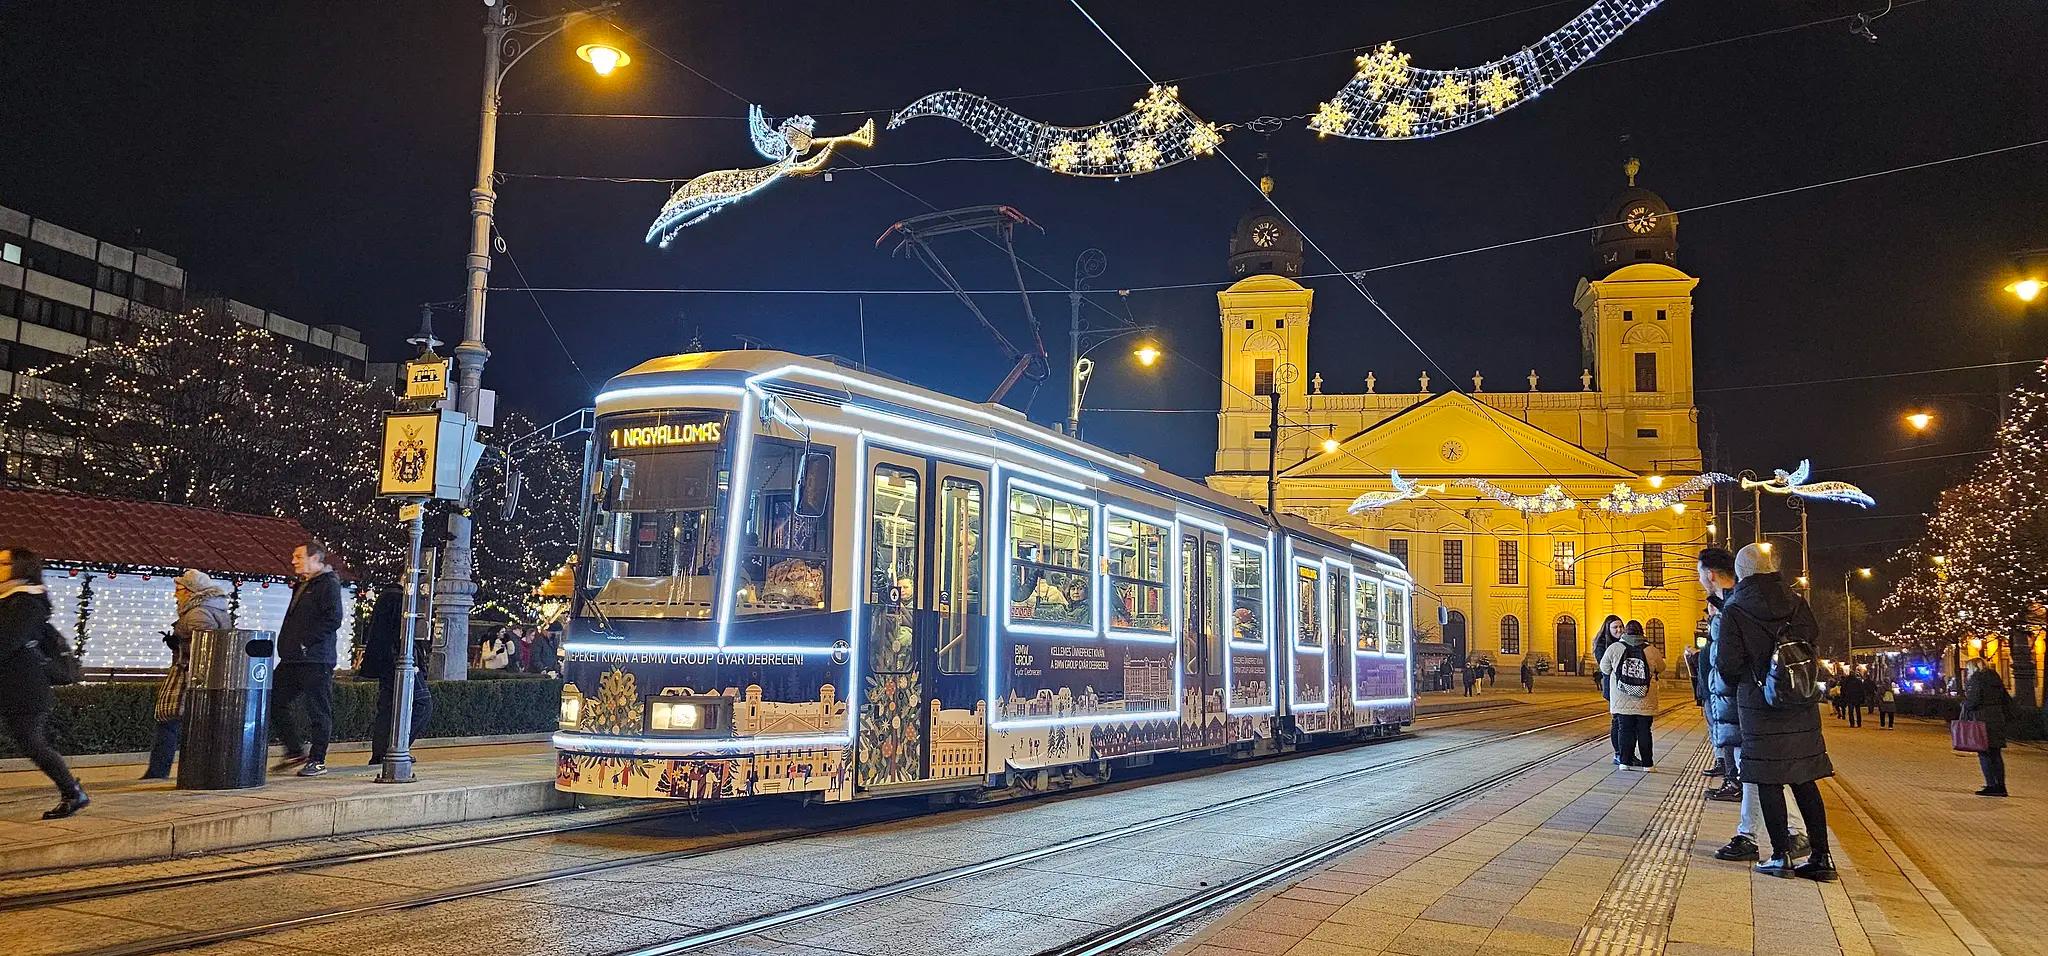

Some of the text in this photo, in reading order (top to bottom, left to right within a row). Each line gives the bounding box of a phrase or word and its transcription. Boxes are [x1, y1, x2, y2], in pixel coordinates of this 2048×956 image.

[610, 429, 618, 448] 1
[1014, 644, 1029, 655] BMW
[631, 652, 639, 664] A
[641, 652, 667, 664] BMW
[671, 653, 714, 665] GROUP
[747, 653, 804, 666] DEBRECEN!
[1014, 655, 1034, 666] GROUP
